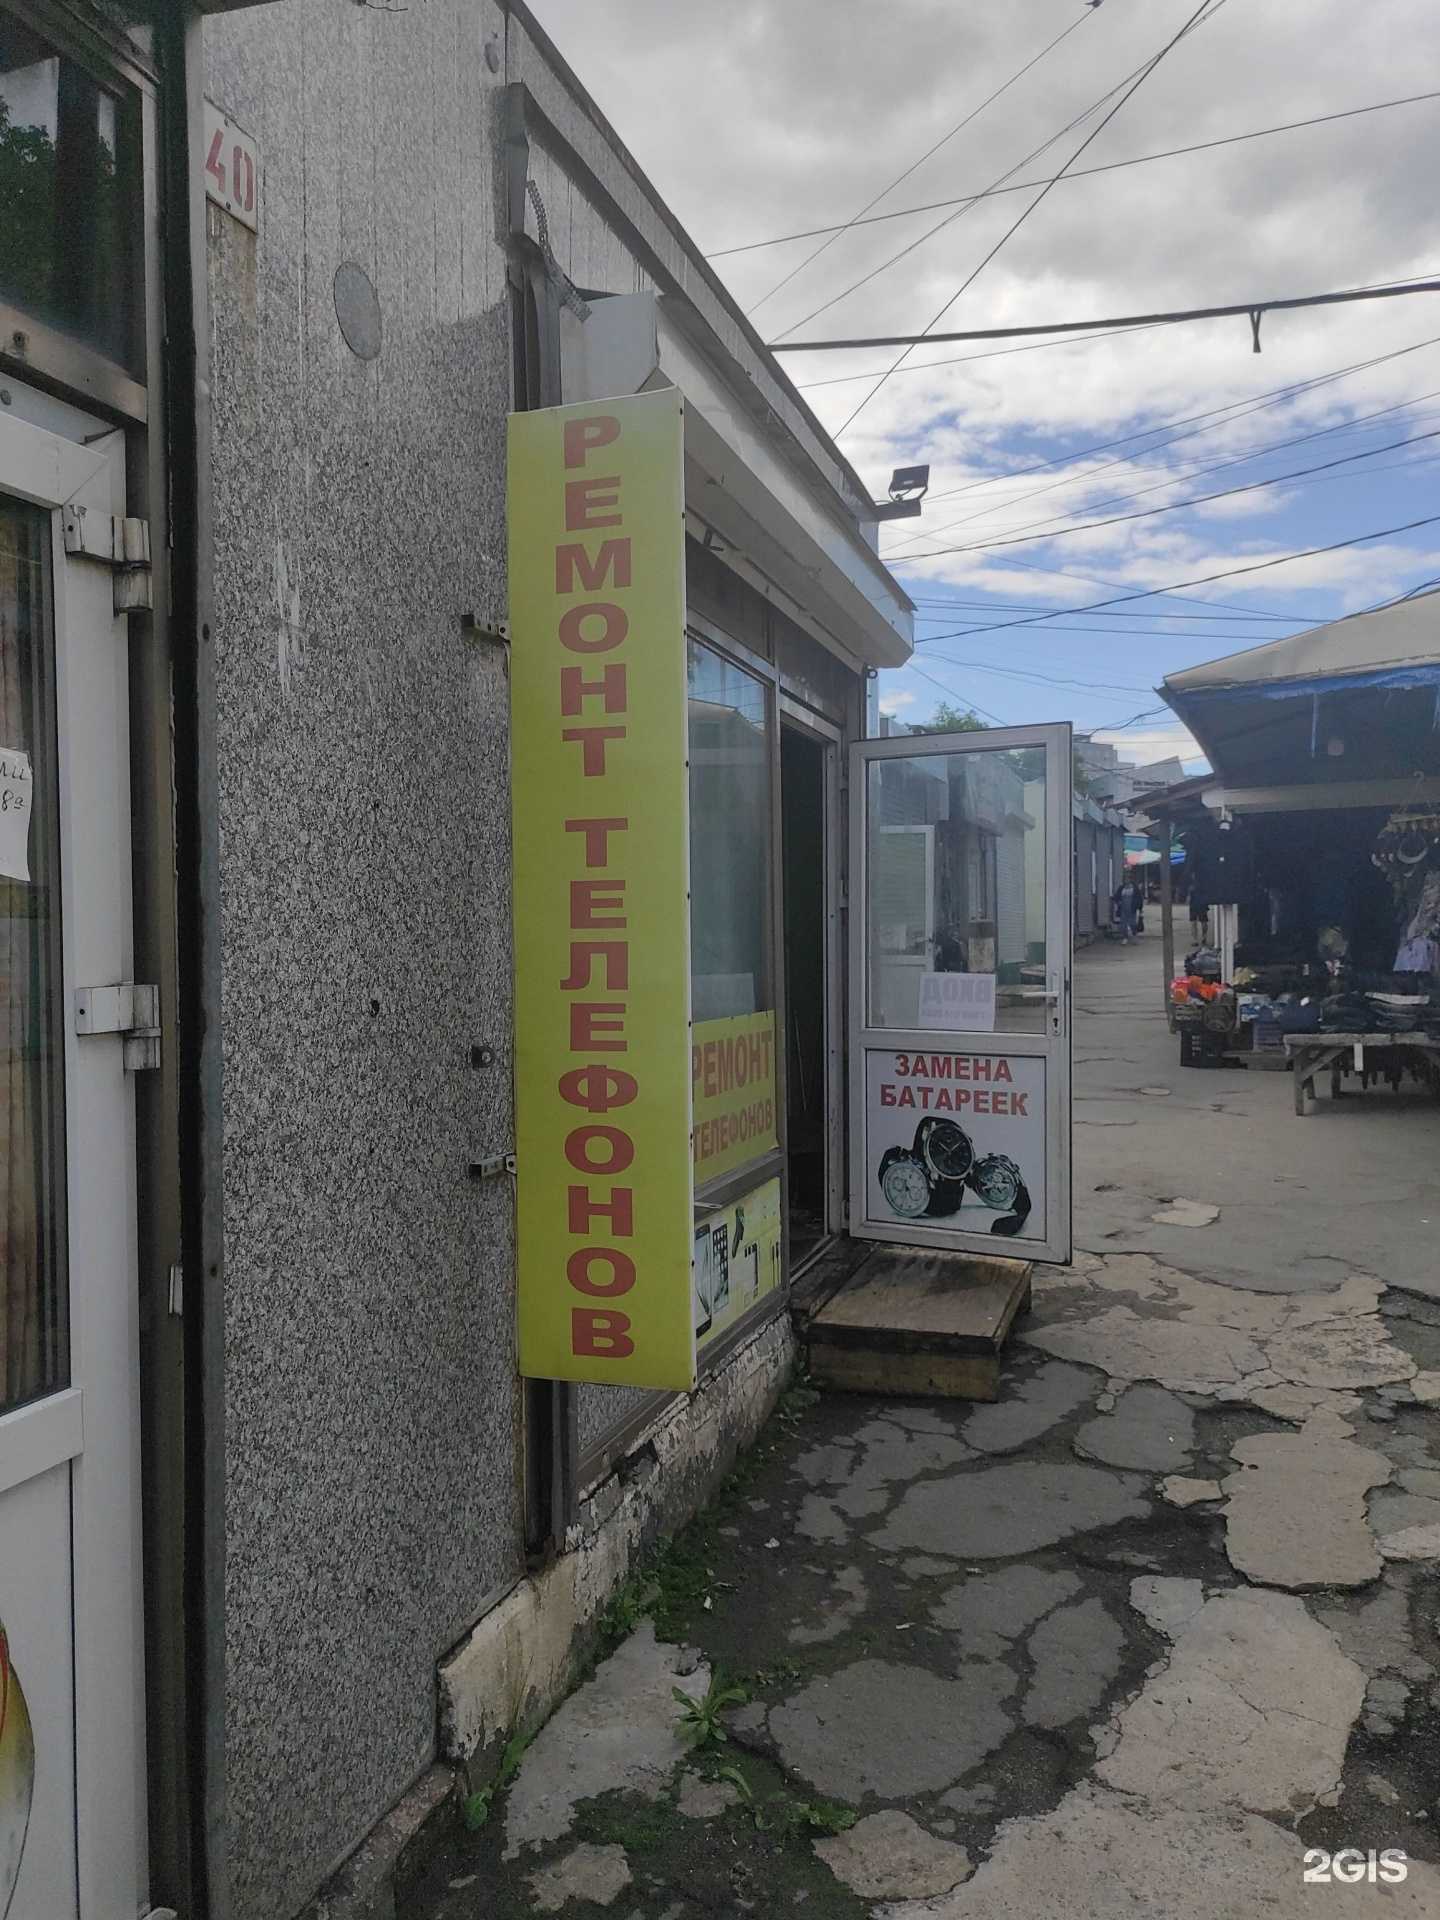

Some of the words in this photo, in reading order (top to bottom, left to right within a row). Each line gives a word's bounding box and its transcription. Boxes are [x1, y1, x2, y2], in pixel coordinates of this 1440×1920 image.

[206, 128, 255, 213] 40
[555, 415, 632, 778] РЕМОНТ
[558, 817, 639, 1359] ТЕЛЕФОНОВ
[692, 1030, 773, 1098] РЕМОНТ
[879, 1084, 1029, 1116] БАТАРЕЕК
[894, 1054, 1013, 1083] ЗАМЕНА
